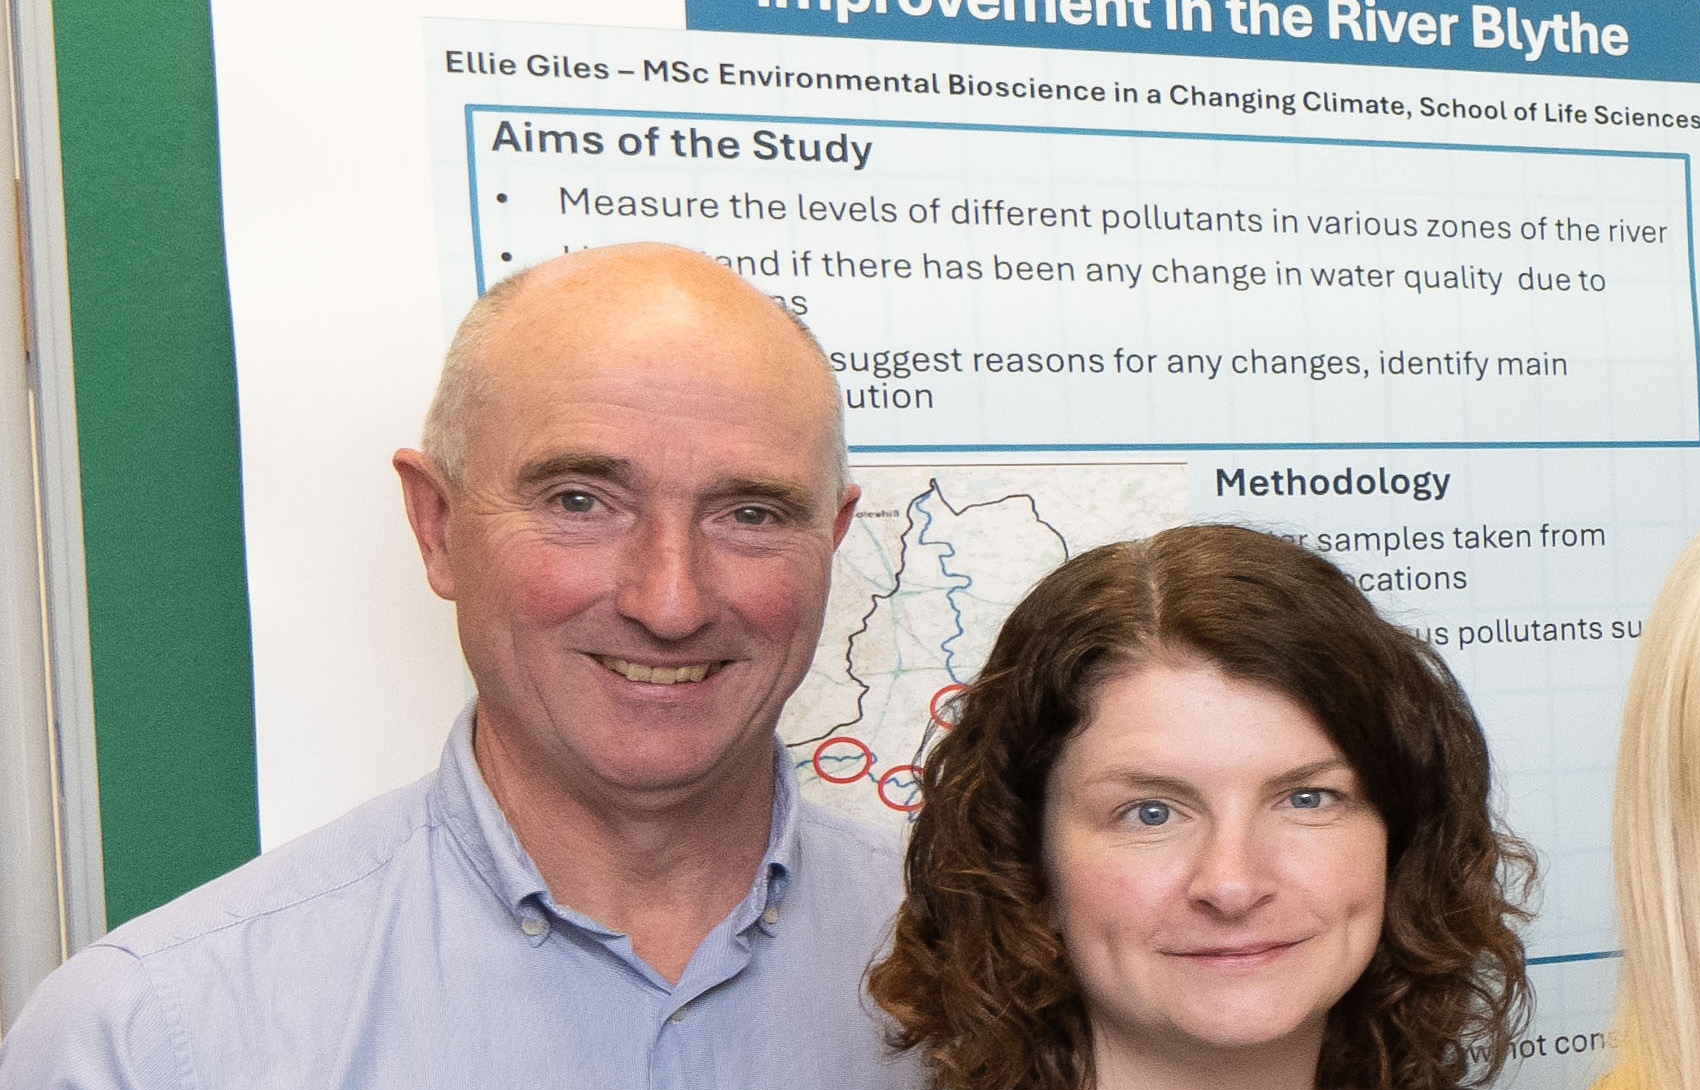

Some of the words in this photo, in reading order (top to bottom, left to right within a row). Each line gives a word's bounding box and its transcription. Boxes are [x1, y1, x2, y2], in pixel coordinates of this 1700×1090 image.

[757, 0, 1152, 29] povement
[1166, 0, 1212, 32] in
[1225, 0, 1313, 38] the
[1328, 0, 1459, 46] River
[1472, 6, 1629, 62] Blythe
[446, 50, 516, 75] Ellie
[527, 54, 609, 79] Giles
[644, 60, 709, 84] MSc
[720, 63, 940, 94] Environmental
[949, 74, 1105, 102] Bioscience
[1114, 82, 1138, 103] in
[1147, 89, 1161, 104] a
[1170, 84, 1296, 116] Changing
[1303, 91, 1412, 119] Climate,
[1420, 97, 1507, 120] School
[1514, 102, 1537, 121] of
[1545, 103, 1587, 124] Life
[1594, 105, 1700, 129] Sciences
[492, 121, 604, 155] Aims
[618, 126, 659, 156] of
[670, 128, 740, 159] the
[753, 130, 873, 171] Study
[560, 187, 719, 218] Measure
[729, 192, 786, 220] the
[798, 194, 897, 223] levels
[909, 198, 940, 223] of
[952, 198, 1092, 228] different
[1102, 204, 1263, 235] pollutants
[1273, 208, 1298, 233] in
[1307, 211, 1417, 237] various
[1427, 219, 1511, 239] zones
[1521, 216, 1547, 240] of
[1555, 217, 1599, 242] the
[1609, 219, 1667, 243] river
[792, 250, 812, 276] if
[821, 251, 911, 278] there
[923, 253, 983, 280] has
[994, 254, 1075, 281] been
[1086, 263, 1142, 289] any
[1152, 258, 1266, 291] change
[1276, 261, 1301, 285] in
[1310, 265, 1395, 287] water
[1404, 265, 1503, 296] quality
[1518, 266, 1571, 291] due
[1578, 270, 1605, 292] to
[830, 348, 964, 380] suggest
[974, 353, 1104, 373] reasons
[1113, 347, 1157, 373] for
[1168, 354, 1222, 380] any
[1232, 349, 1369, 381] changes,
[1380, 350, 1489, 381] identify
[1498, 352, 1567, 376] main
[1216, 467, 1451, 501] Methodology
